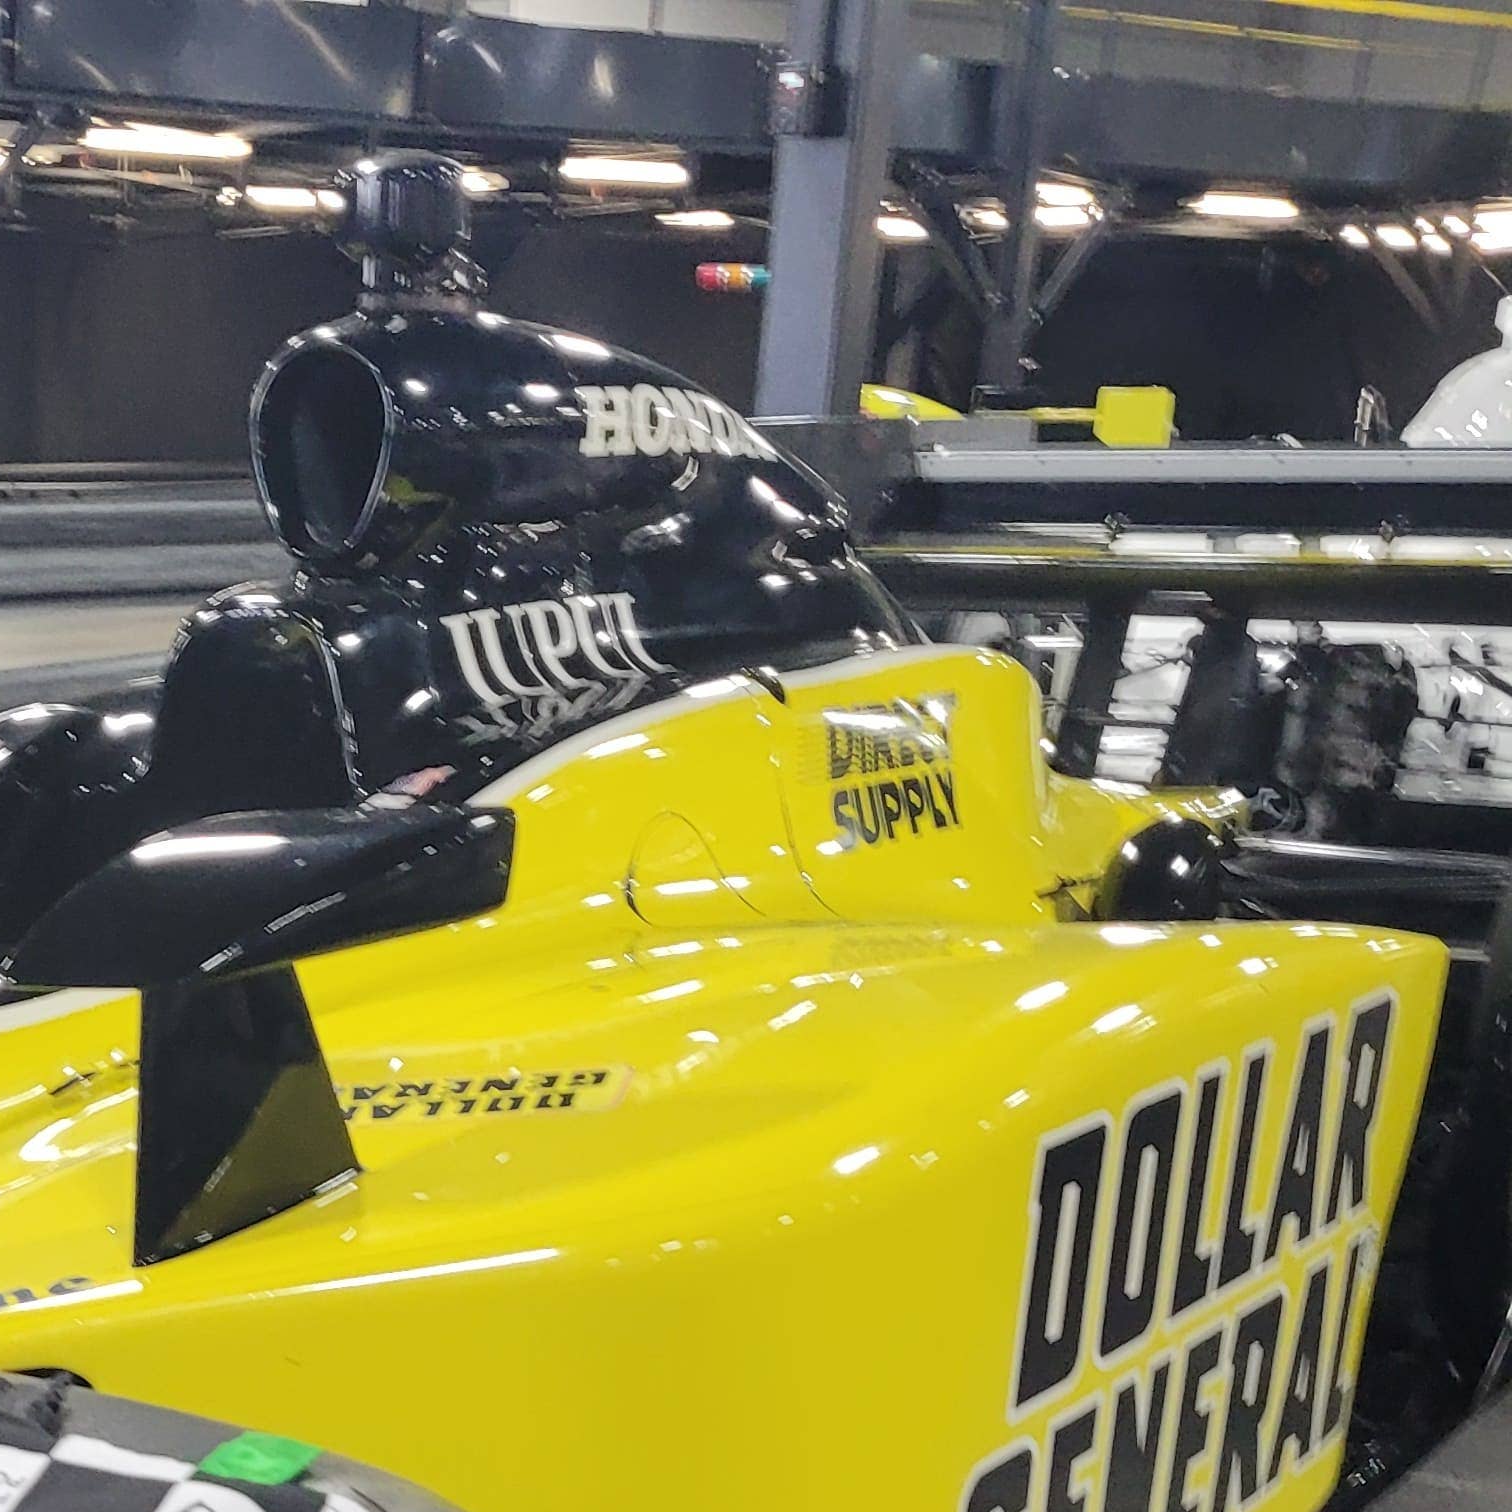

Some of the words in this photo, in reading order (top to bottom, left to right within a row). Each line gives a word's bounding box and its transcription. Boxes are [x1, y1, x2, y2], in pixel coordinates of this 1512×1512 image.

[833, 770, 960, 850] SUPPLY
[336, 1071, 607, 1100] GENERA
[1008, 992, 1396, 1424] DOLLAR
